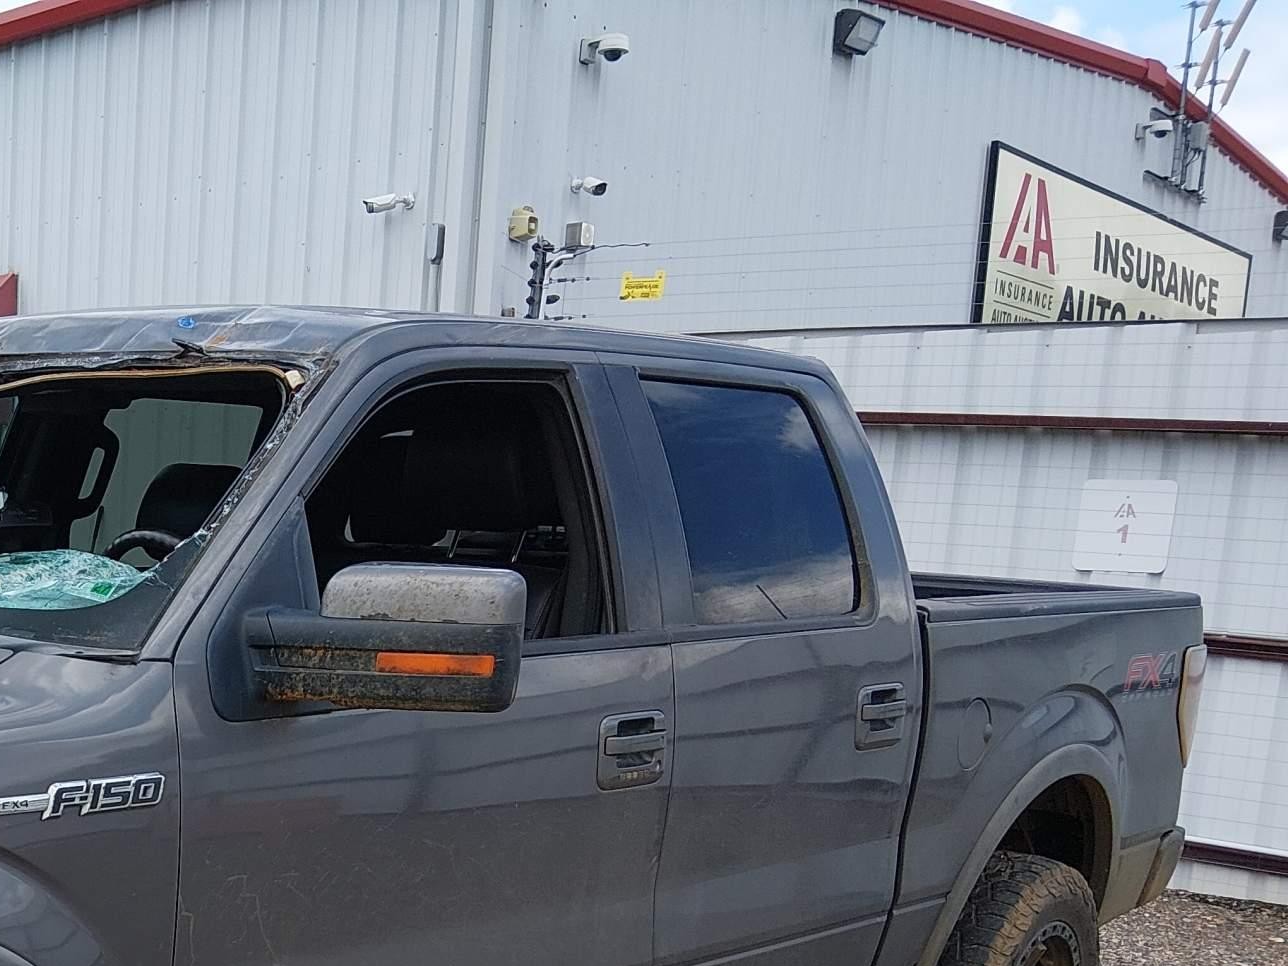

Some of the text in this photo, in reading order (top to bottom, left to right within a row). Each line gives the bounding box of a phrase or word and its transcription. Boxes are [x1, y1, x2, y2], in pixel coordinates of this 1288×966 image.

[1093, 230, 1219, 317] INSURANCE
[994, 277, 1054, 311] INSURANCE
[1116, 523, 1129, 543] 1
[1123, 652, 1177, 691] FX4
[1, 799, 30, 810] FX4
